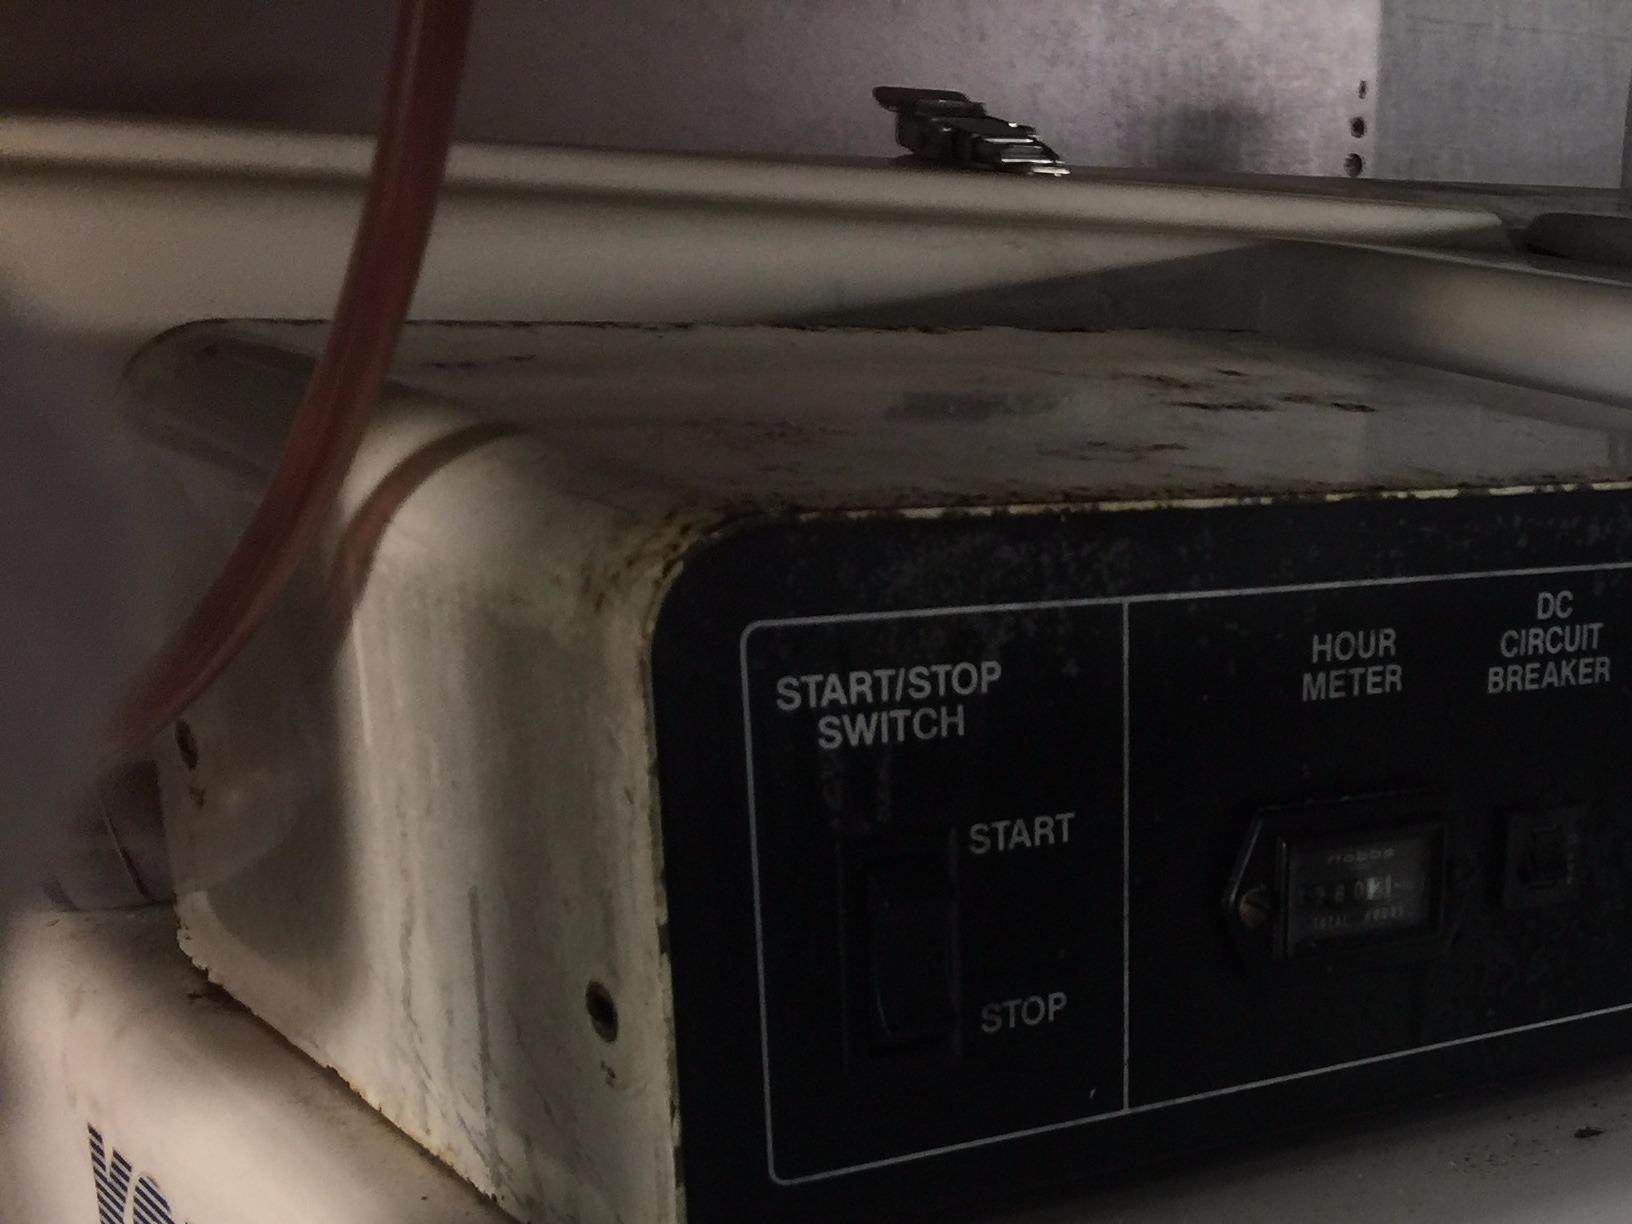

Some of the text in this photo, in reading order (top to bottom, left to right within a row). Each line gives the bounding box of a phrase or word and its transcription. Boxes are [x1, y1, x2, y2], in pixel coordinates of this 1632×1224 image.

[1537, 590, 1574, 620] DC
[1311, 628, 1396, 663] HOUR
[1500, 622, 1604, 659] CIRCUIT
[776, 660, 1002, 712] START/STOP
[1303, 662, 1403, 701] METER
[1487, 656, 1611, 694] BREAKER
[817, 704, 966, 750] SWITCH
[968, 811, 1076, 855] START
[980, 991, 1068, 1034] STOP
